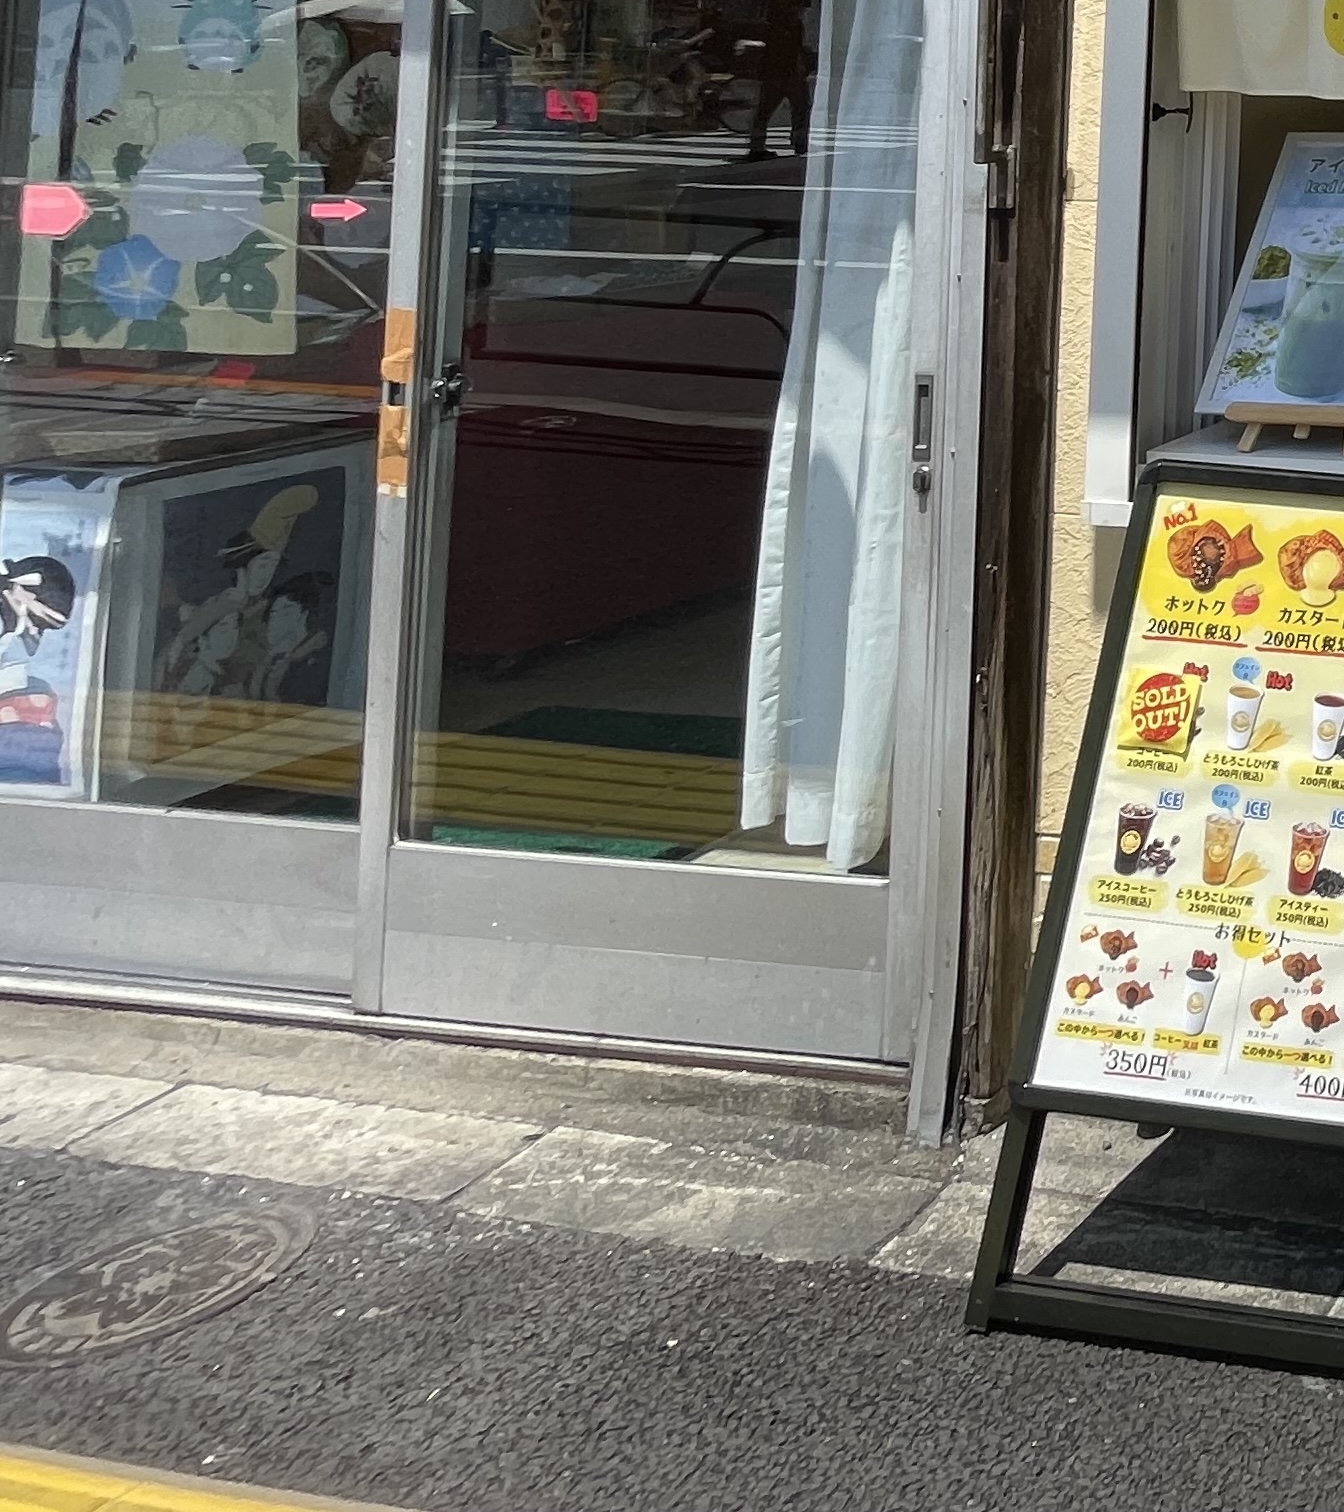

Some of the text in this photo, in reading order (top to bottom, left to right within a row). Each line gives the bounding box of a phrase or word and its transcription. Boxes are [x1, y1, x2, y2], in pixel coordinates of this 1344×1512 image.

[1305, 179, 1338, 194] Iced
[1164, 595, 1226, 616] ホットク
[1266, 671, 1294, 691] Hot
[1133, 682, 1191, 711] SOLD
[1132, 701, 1187, 732] OUT!
[1202, 753, 1280, 771] とうもろこしひげ茶
[1159, 791, 1182, 807] ICE
[1245, 801, 1269, 817] ICE
[1097, 879, 1157, 894] アイスコーヒー
[1279, 899, 1329, 913] アイスティー
[1214, 922, 1292, 948] お得セット
[1192, 949, 1218, 970] Hot
